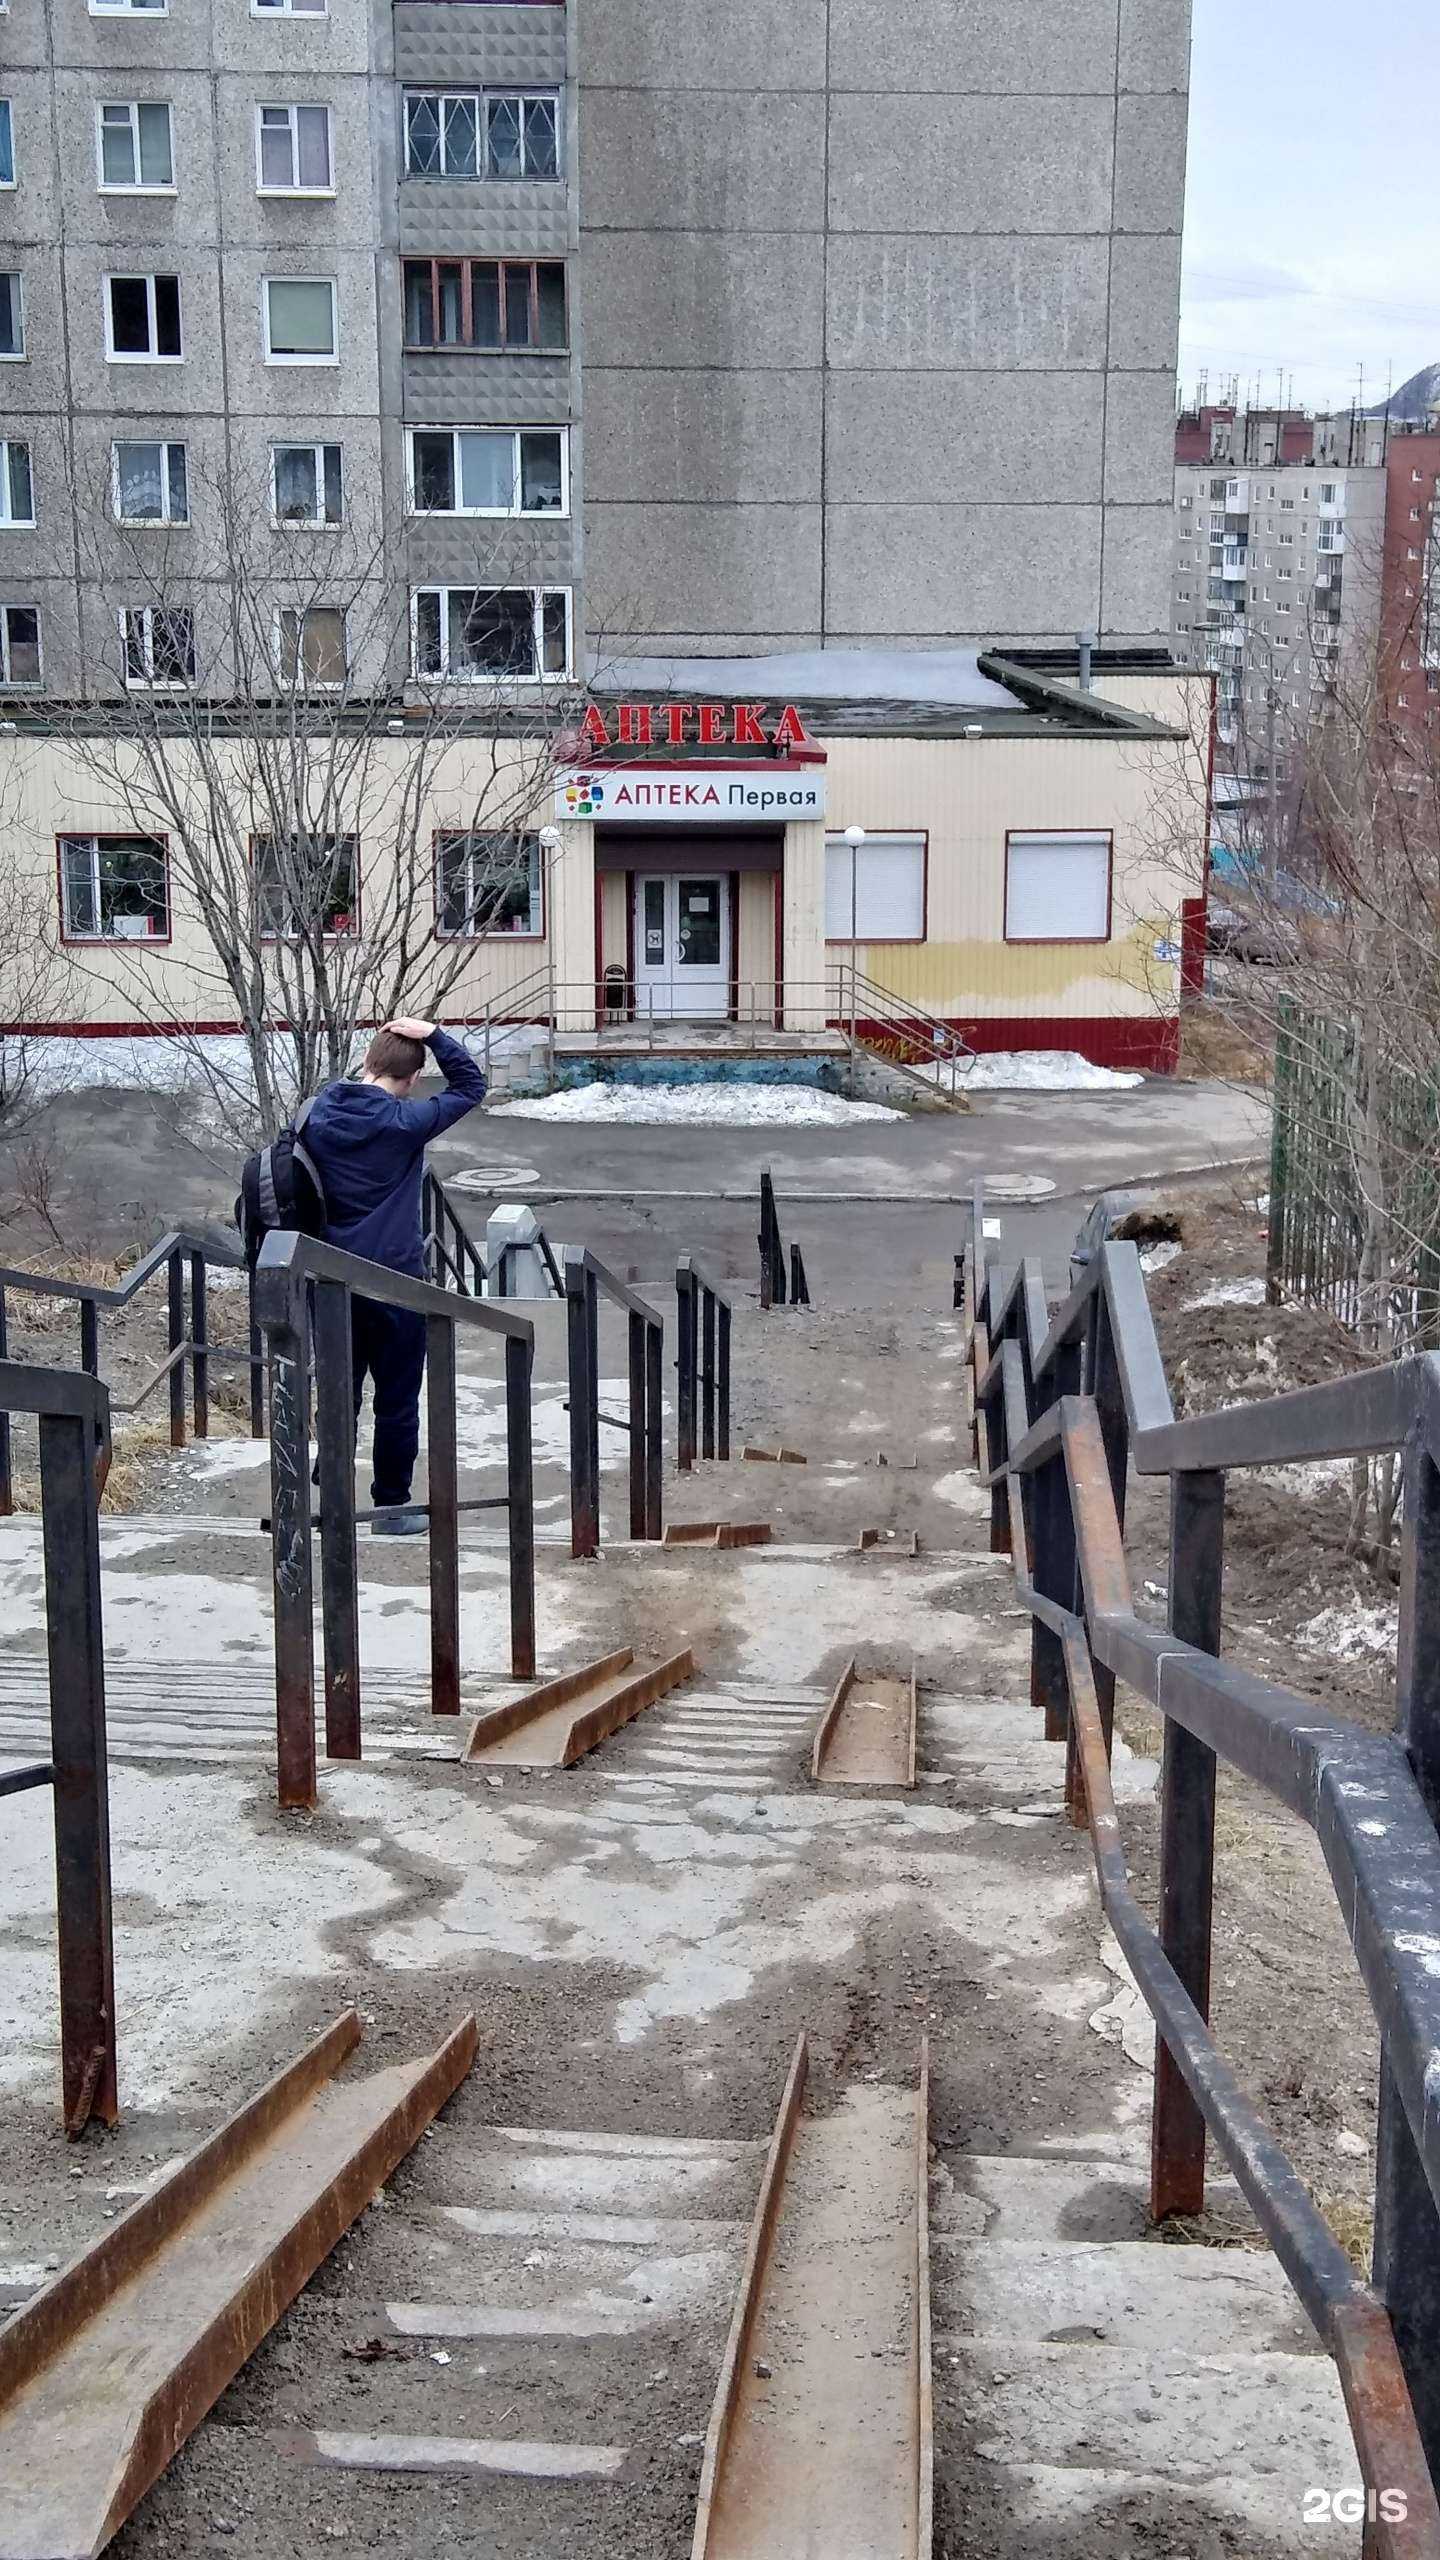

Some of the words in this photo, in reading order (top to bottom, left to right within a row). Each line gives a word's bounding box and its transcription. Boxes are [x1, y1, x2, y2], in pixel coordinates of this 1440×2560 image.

[581, 704, 807, 744] АПТЕКА
[614, 784, 720, 805] АПТЕКА
[728, 784, 816, 810] Первая
